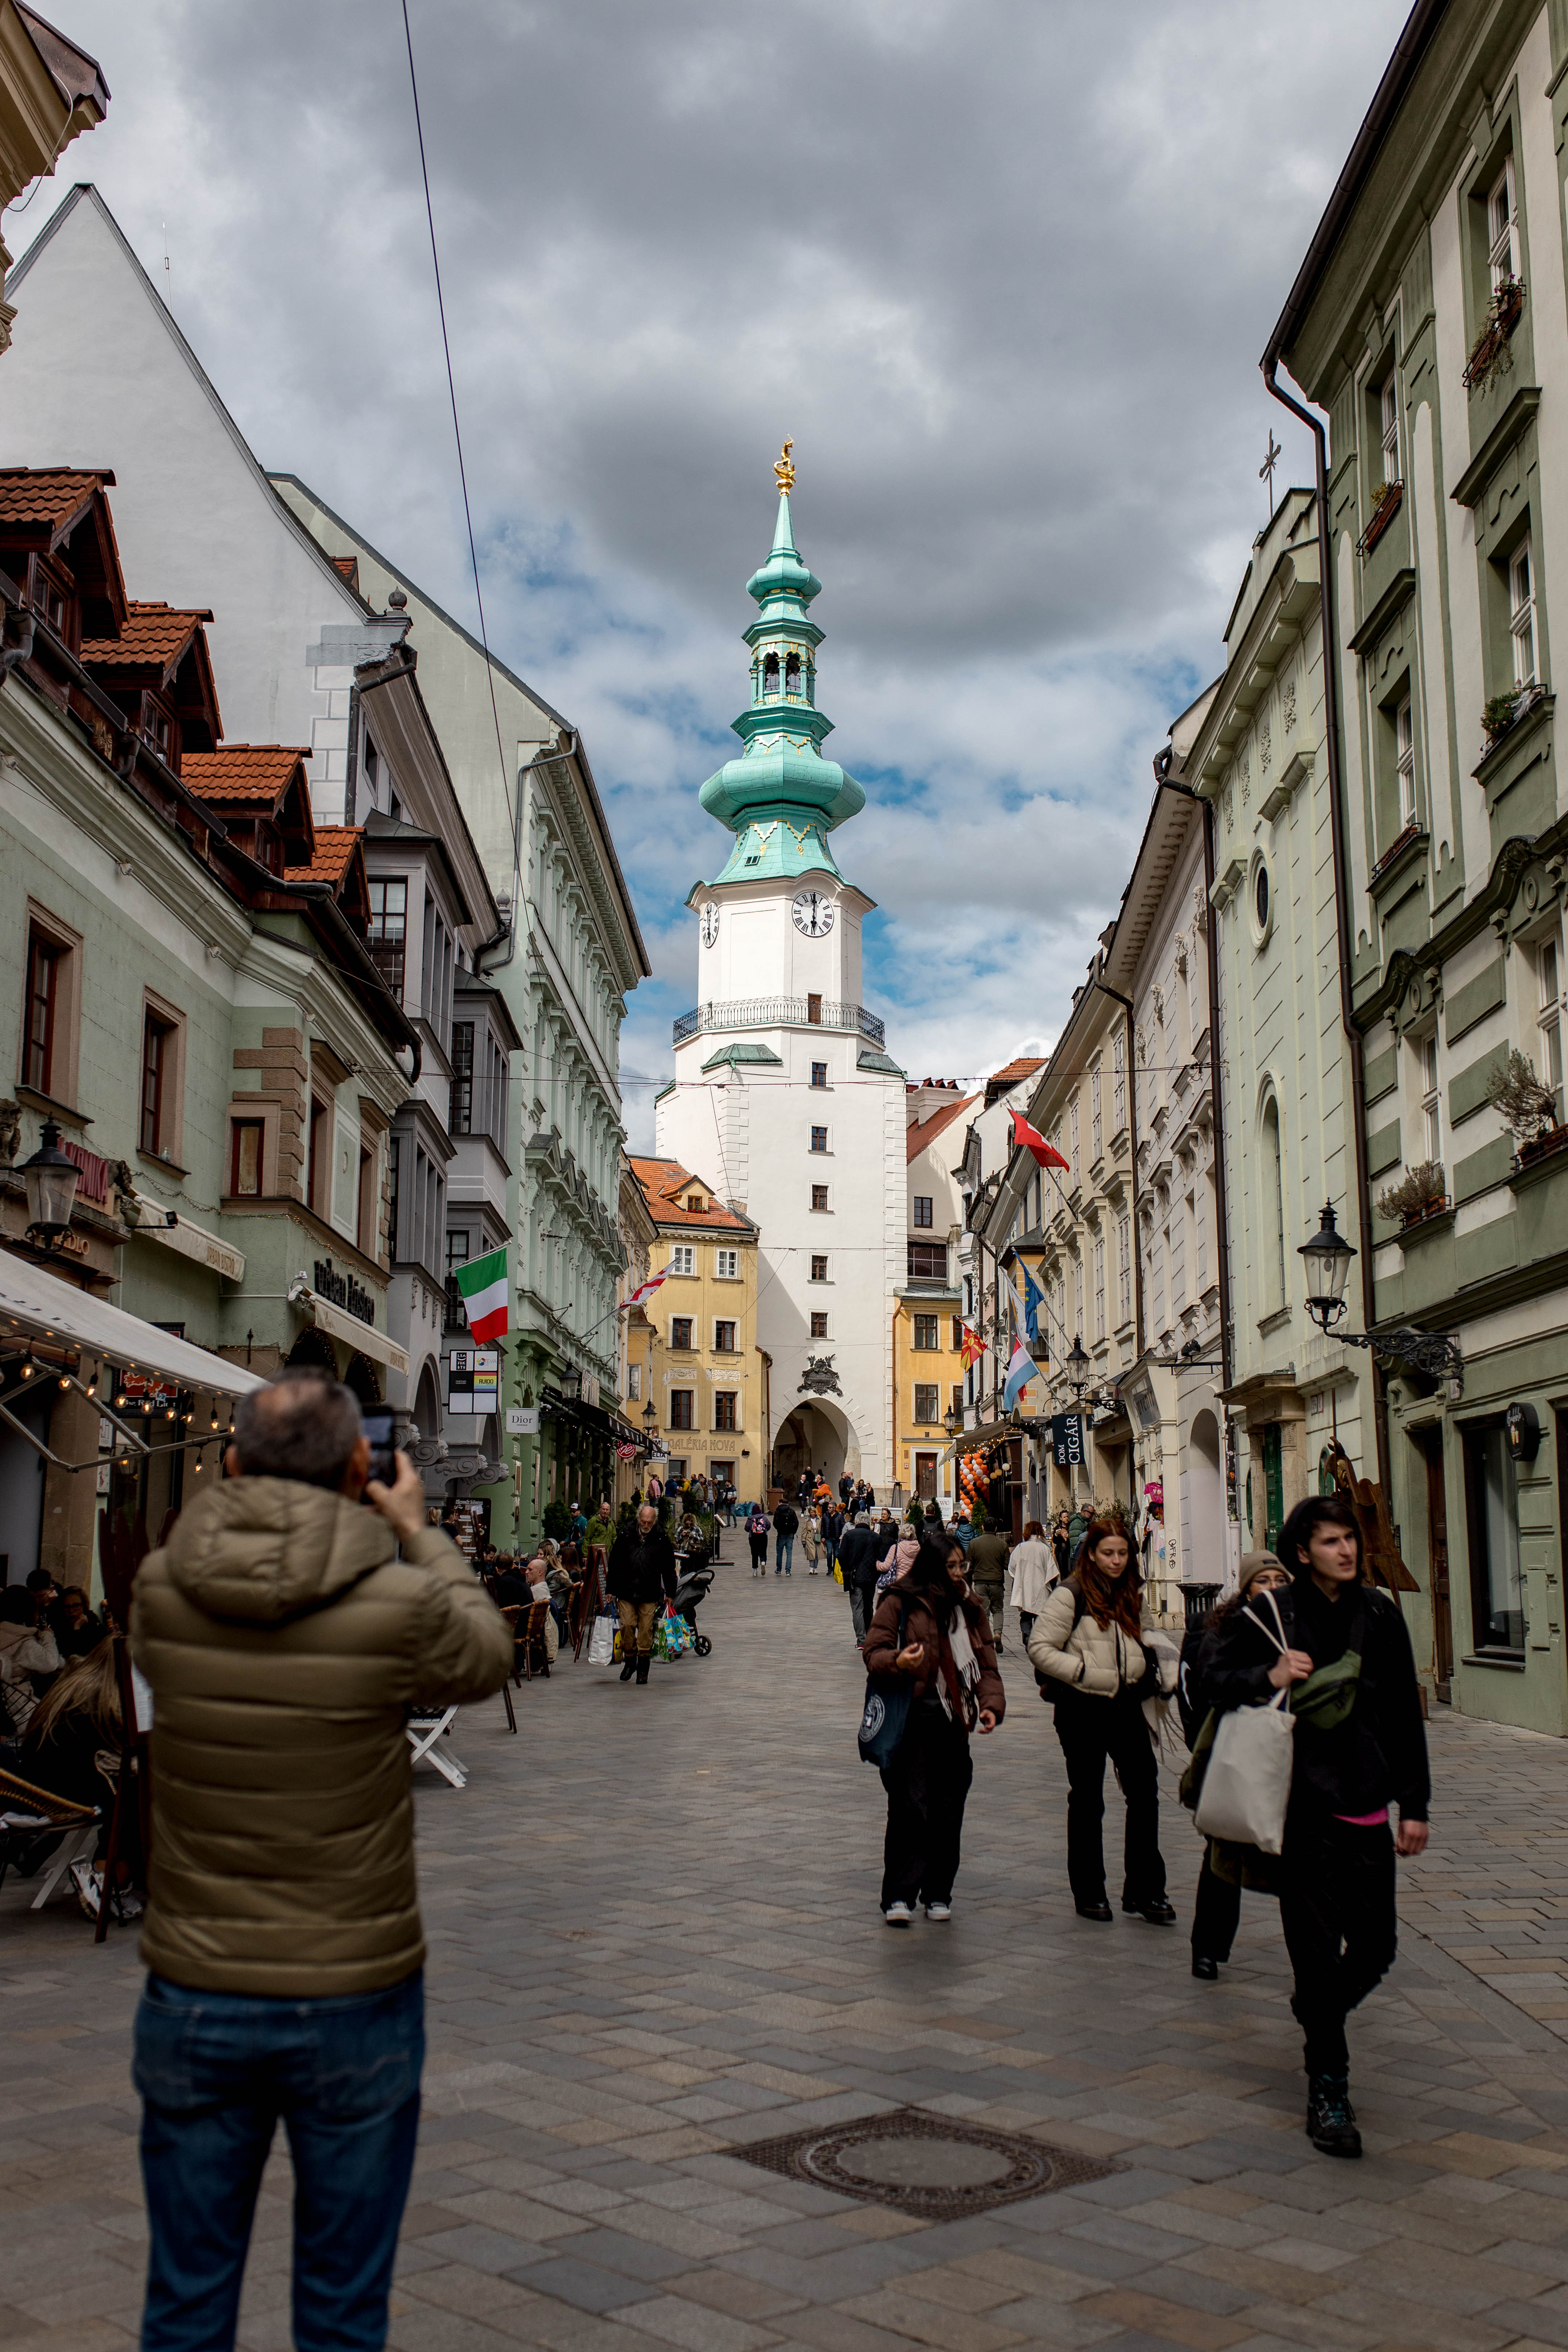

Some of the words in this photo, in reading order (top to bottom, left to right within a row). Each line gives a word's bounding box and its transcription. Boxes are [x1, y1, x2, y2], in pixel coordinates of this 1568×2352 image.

[207, 1246, 220, 1268] URBAN
[221, 1253, 235, 1275] BISTRO
[668, 1436, 707, 1450] GALÉRIA
[710, 1439, 735, 1451] NOVA
[1064, 1415, 1080, 1464] CIGÁR
